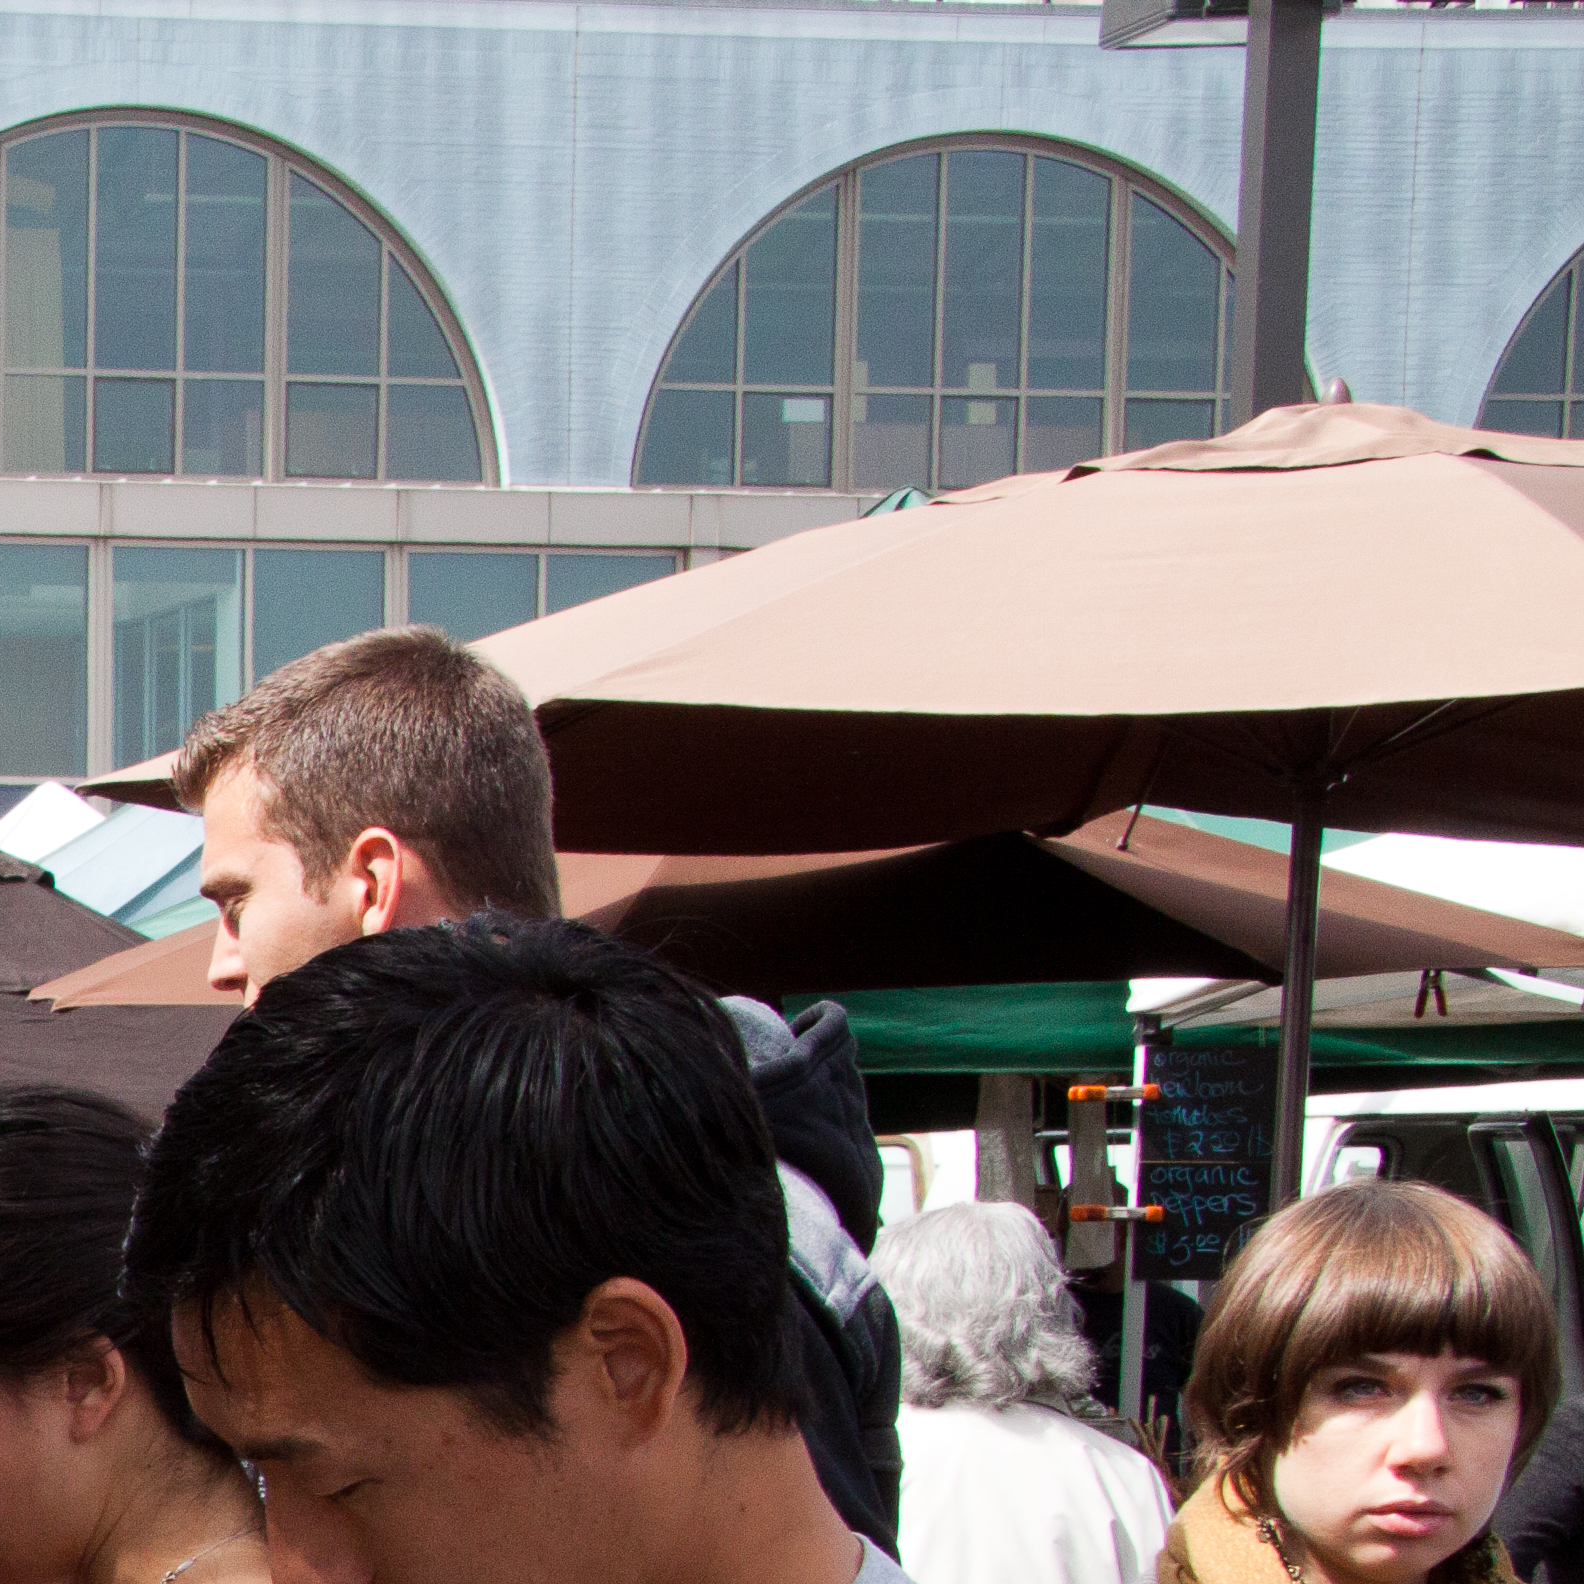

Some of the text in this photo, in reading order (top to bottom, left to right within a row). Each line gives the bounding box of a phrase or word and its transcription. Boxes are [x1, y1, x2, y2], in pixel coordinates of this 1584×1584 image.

[1153, 1050, 1247, 1078] organic
[1150, 1165, 1259, 1195] organic
[1150, 1188, 1257, 1228] peppers
